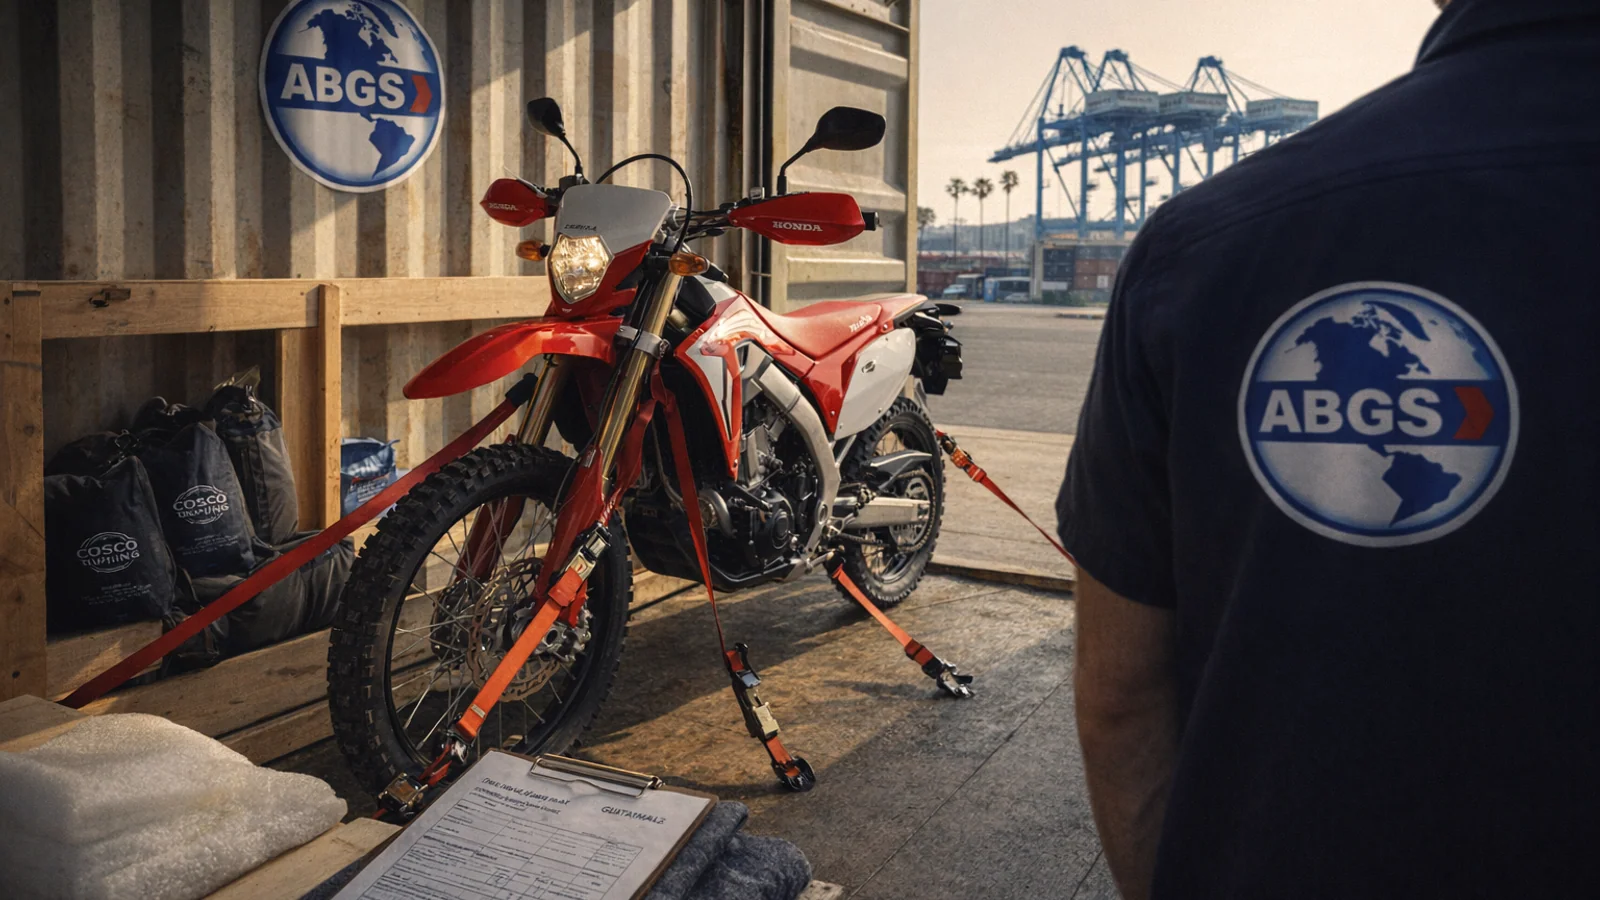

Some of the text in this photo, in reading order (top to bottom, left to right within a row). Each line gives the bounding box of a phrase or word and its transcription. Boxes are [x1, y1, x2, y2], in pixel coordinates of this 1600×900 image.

[280, 62, 405, 110] ABGS
[772, 221, 823, 232] HONDA
[1258, 388, 1443, 438] ABGS
[172, 493, 227, 511] COSCO
[76, 540, 138, 559] COSCO
